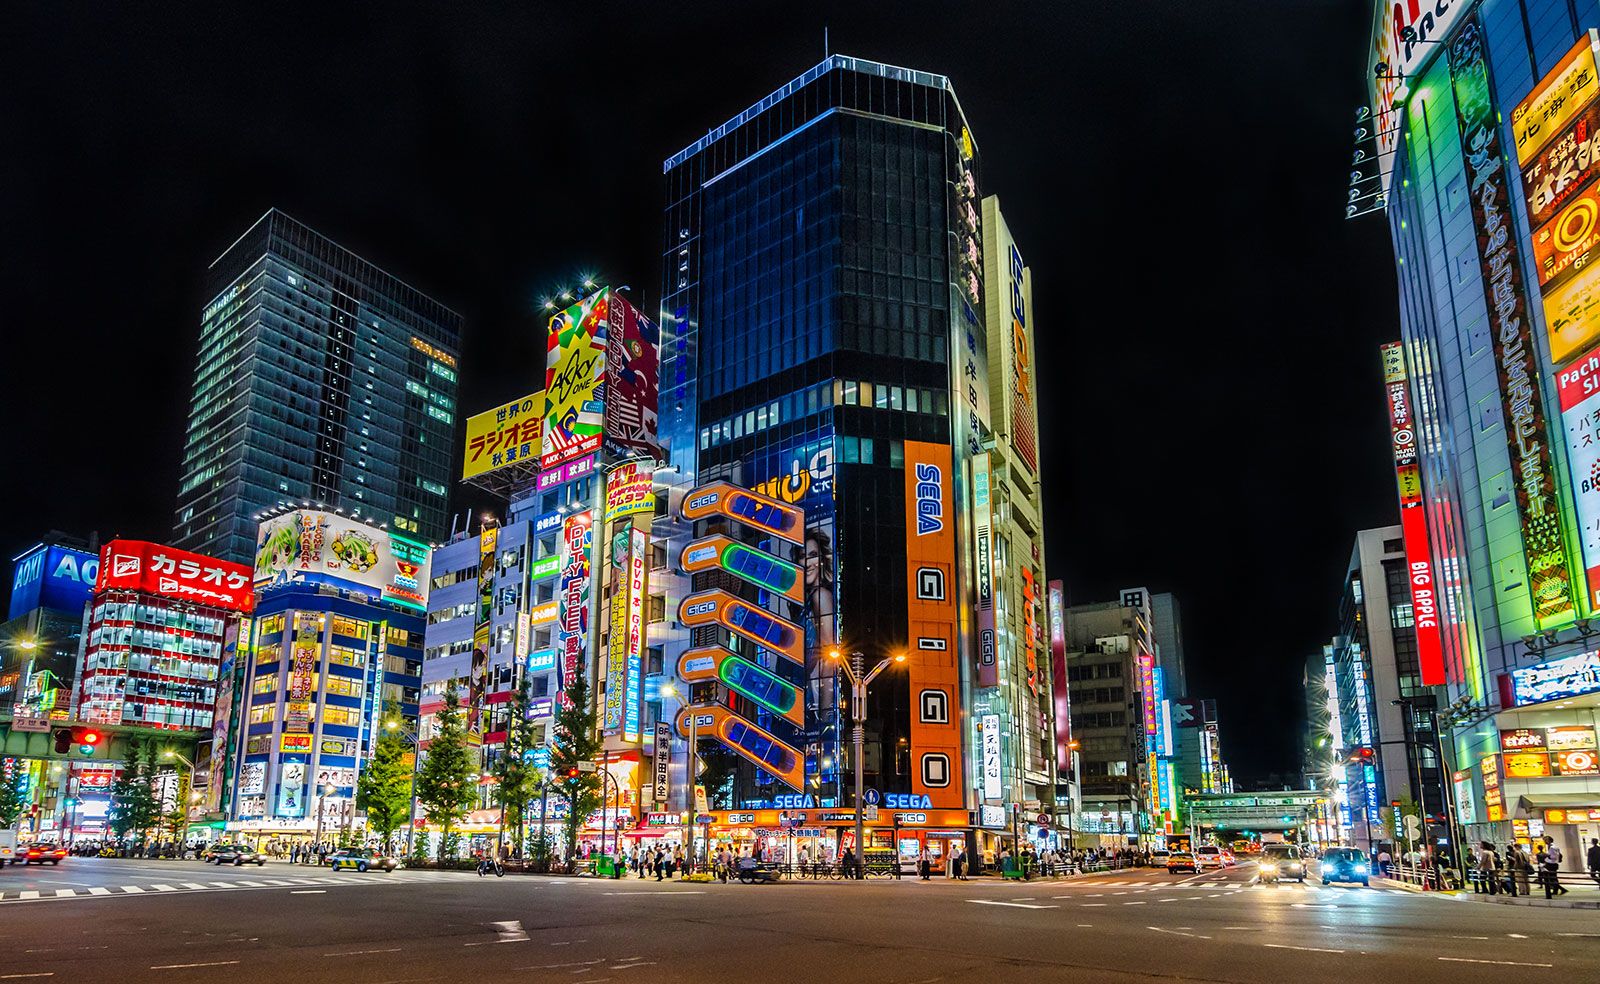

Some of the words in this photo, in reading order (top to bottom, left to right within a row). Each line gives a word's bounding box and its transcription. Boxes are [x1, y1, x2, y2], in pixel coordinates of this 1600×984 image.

[1514, 103, 1528, 121] 8F
[1518, 68, 1594, 148] 北海道
[1525, 164, 1541, 184] 7F
[1573, 252, 1590, 270] 6F
[573, 379, 591, 395] ONE
[496, 400, 533, 423] 世界の
[491, 442, 531, 466] 秋葉原
[689, 493, 719, 510] GiGO
[915, 462, 944, 536] SEGA
[975, 471, 989, 508] SEGA
[300, 515, 311, 569] AKIHABARA
[570, 525, 585, 576] DUTY
[14, 554, 42, 590] AOKI
[150, 554, 249, 589] カラオケ
[633, 558, 643, 590] DVD
[1411, 561, 1430, 585] BIG
[565, 578, 583, 634] FREE
[687, 601, 716, 616] GiGO
[1414, 589, 1436, 628] APPLE
[630, 614, 640, 655] GAME
[1022, 566, 1038, 698] HOBBY
[981, 628, 995, 667] GiGO
[302, 649, 316, 699] インターネット
[657, 727, 671, 737] 8F
[773, 795, 815, 808] SEGA
[886, 793, 933, 809] SEGA
[665, 815, 679, 824] 買取
[728, 813, 755, 824] GiGO
